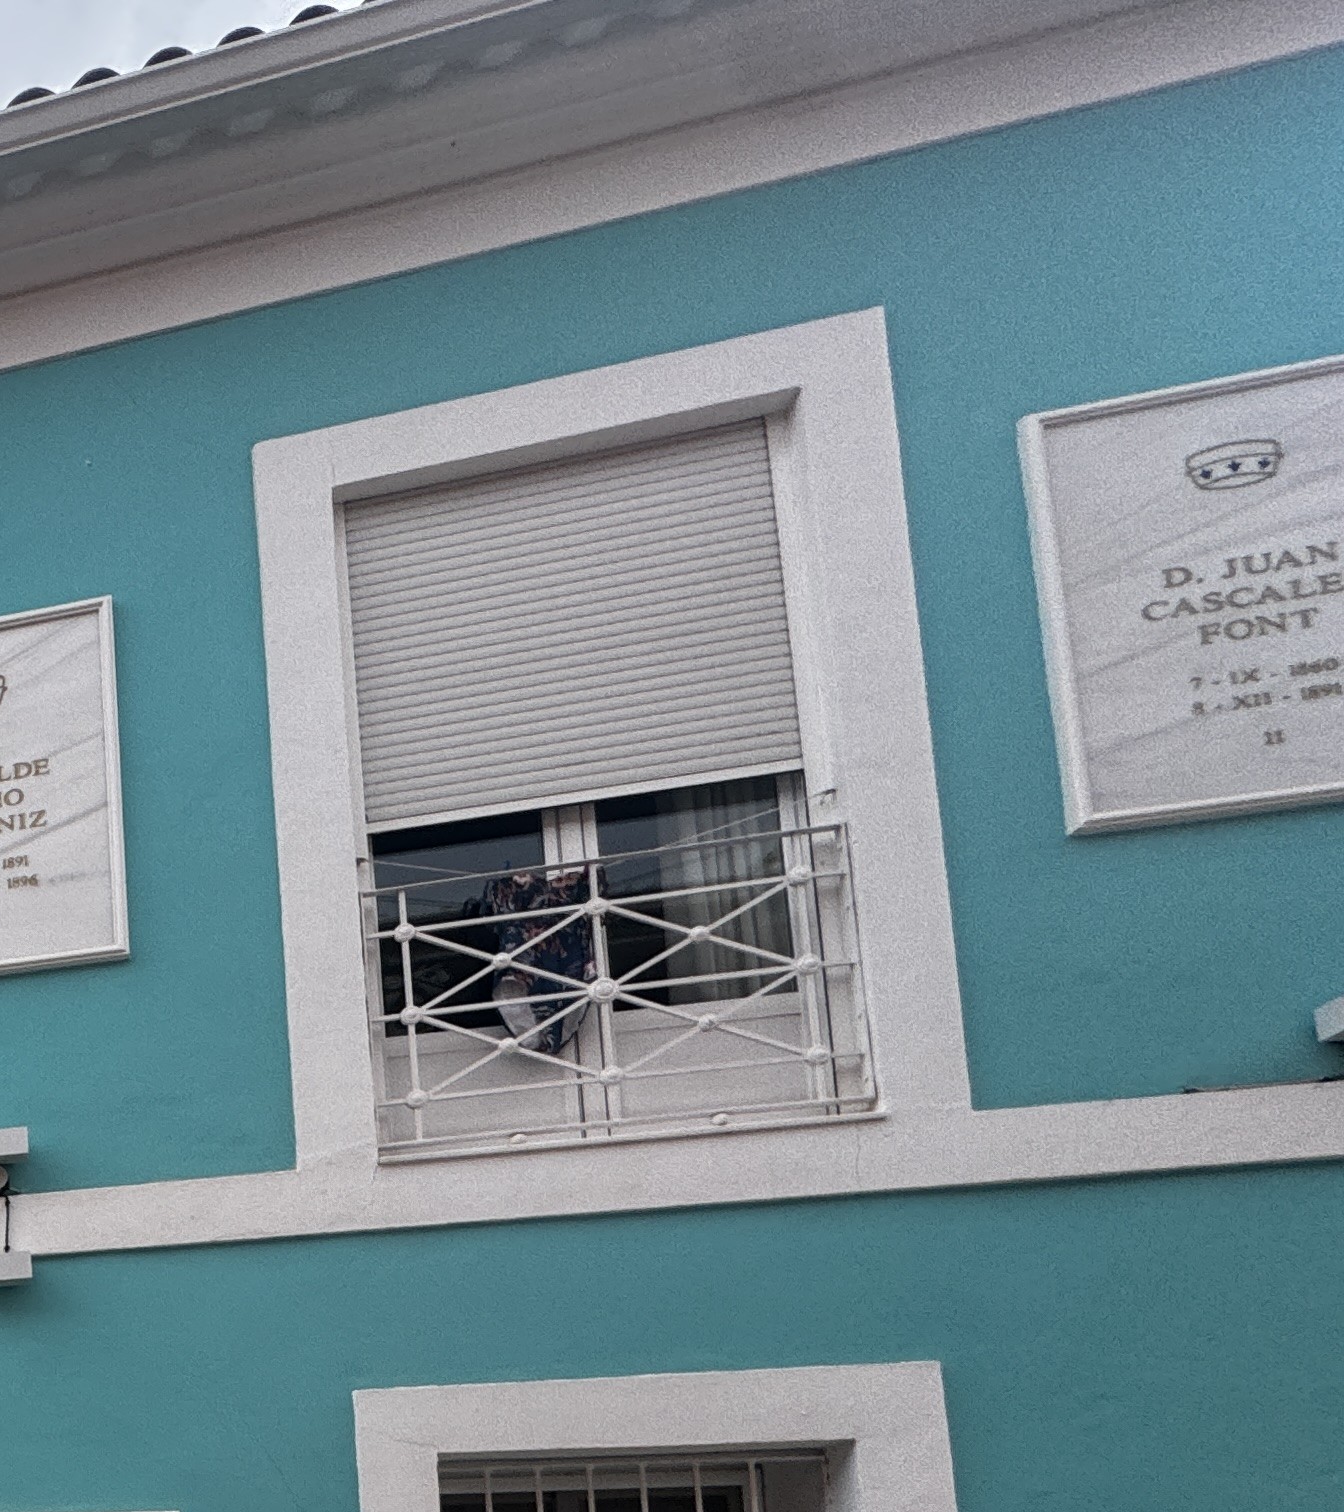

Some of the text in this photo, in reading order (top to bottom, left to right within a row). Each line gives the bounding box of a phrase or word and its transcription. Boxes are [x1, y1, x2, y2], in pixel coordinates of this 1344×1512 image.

[1162, 541, 1339, 589] D. JUAN
[1198, 607, 1318, 645] FONT
[2, 855, 29, 870] 1891
